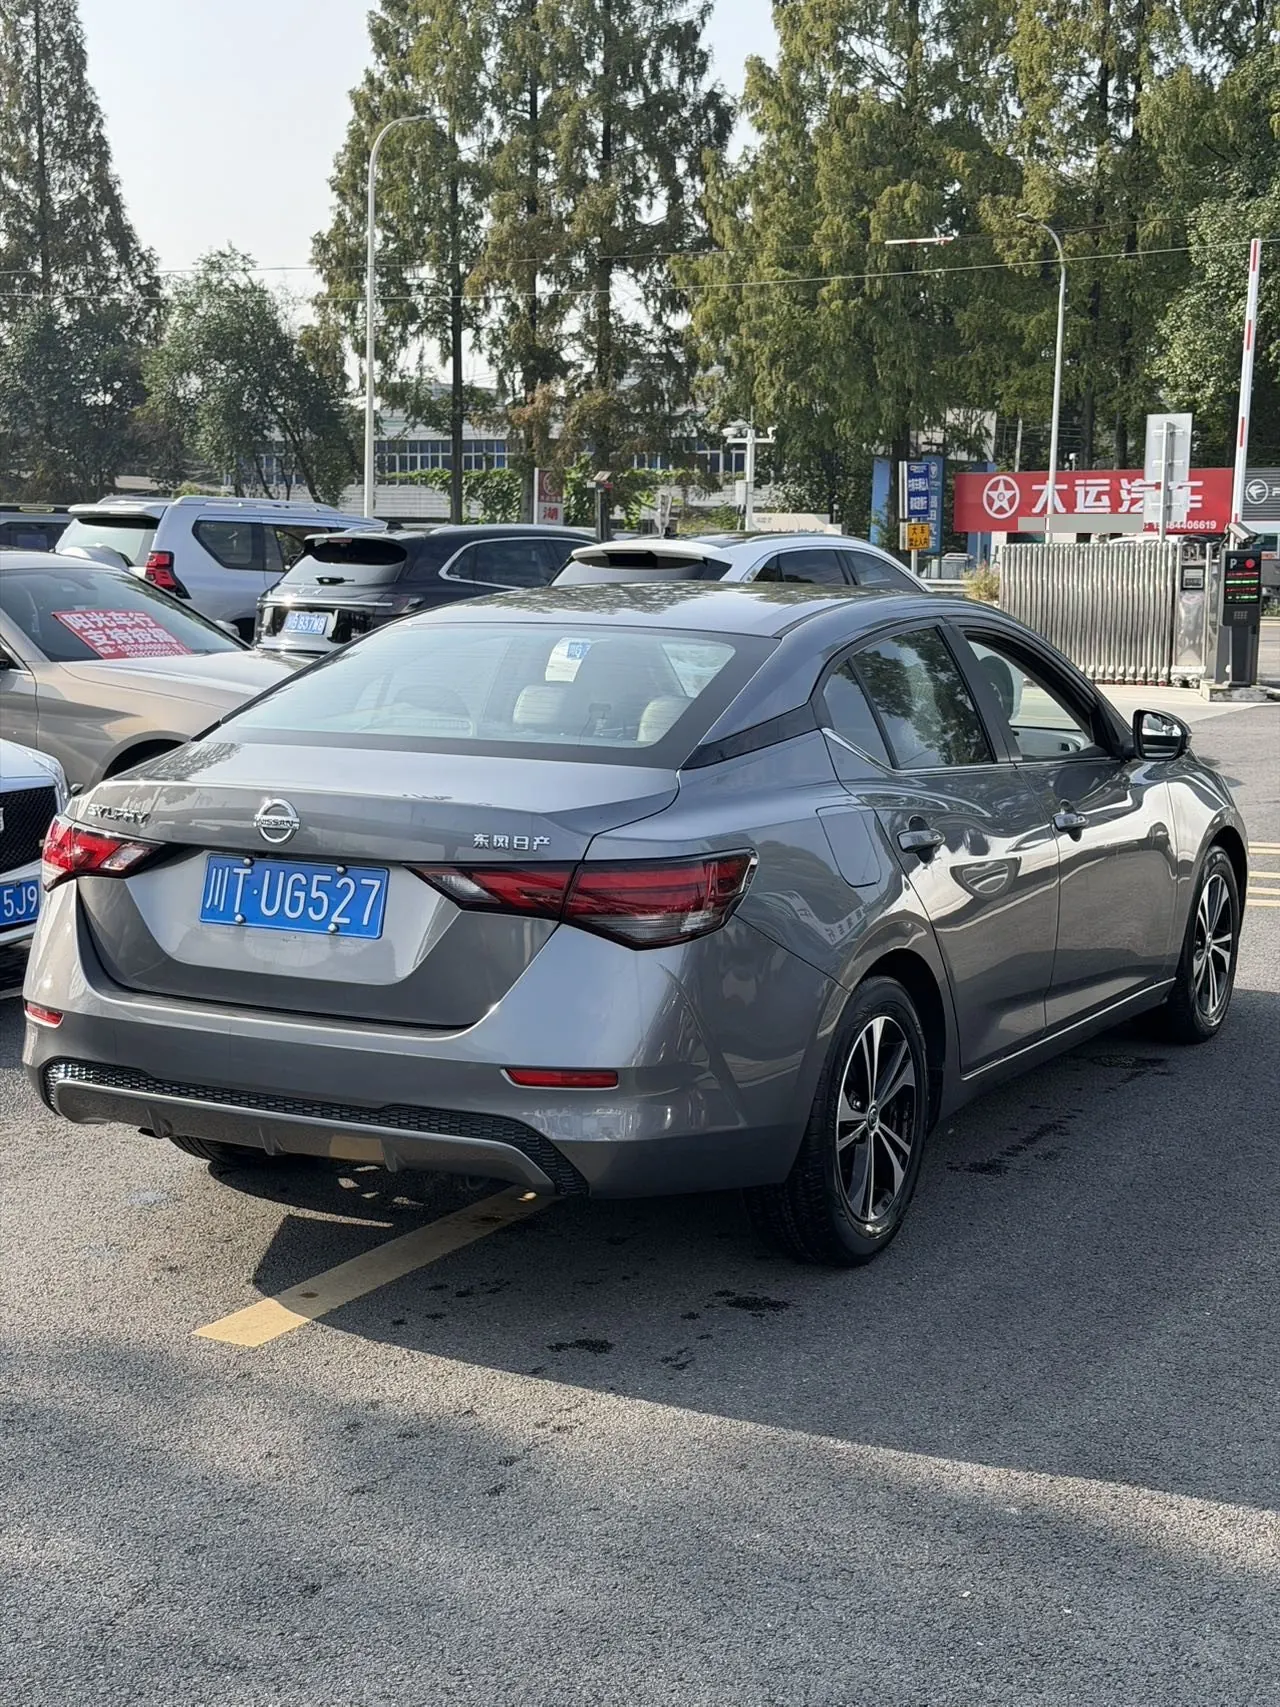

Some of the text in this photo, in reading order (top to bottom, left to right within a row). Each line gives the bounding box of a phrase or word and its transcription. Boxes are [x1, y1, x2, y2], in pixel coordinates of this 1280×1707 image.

[1230, 558, 1238, 569] P
[60, 611, 156, 630] 阳光车行
[87, 803, 151, 826] SYLPHY
[260, 816, 296, 829] NISSAN
[473, 833, 551, 850] 东风日产
